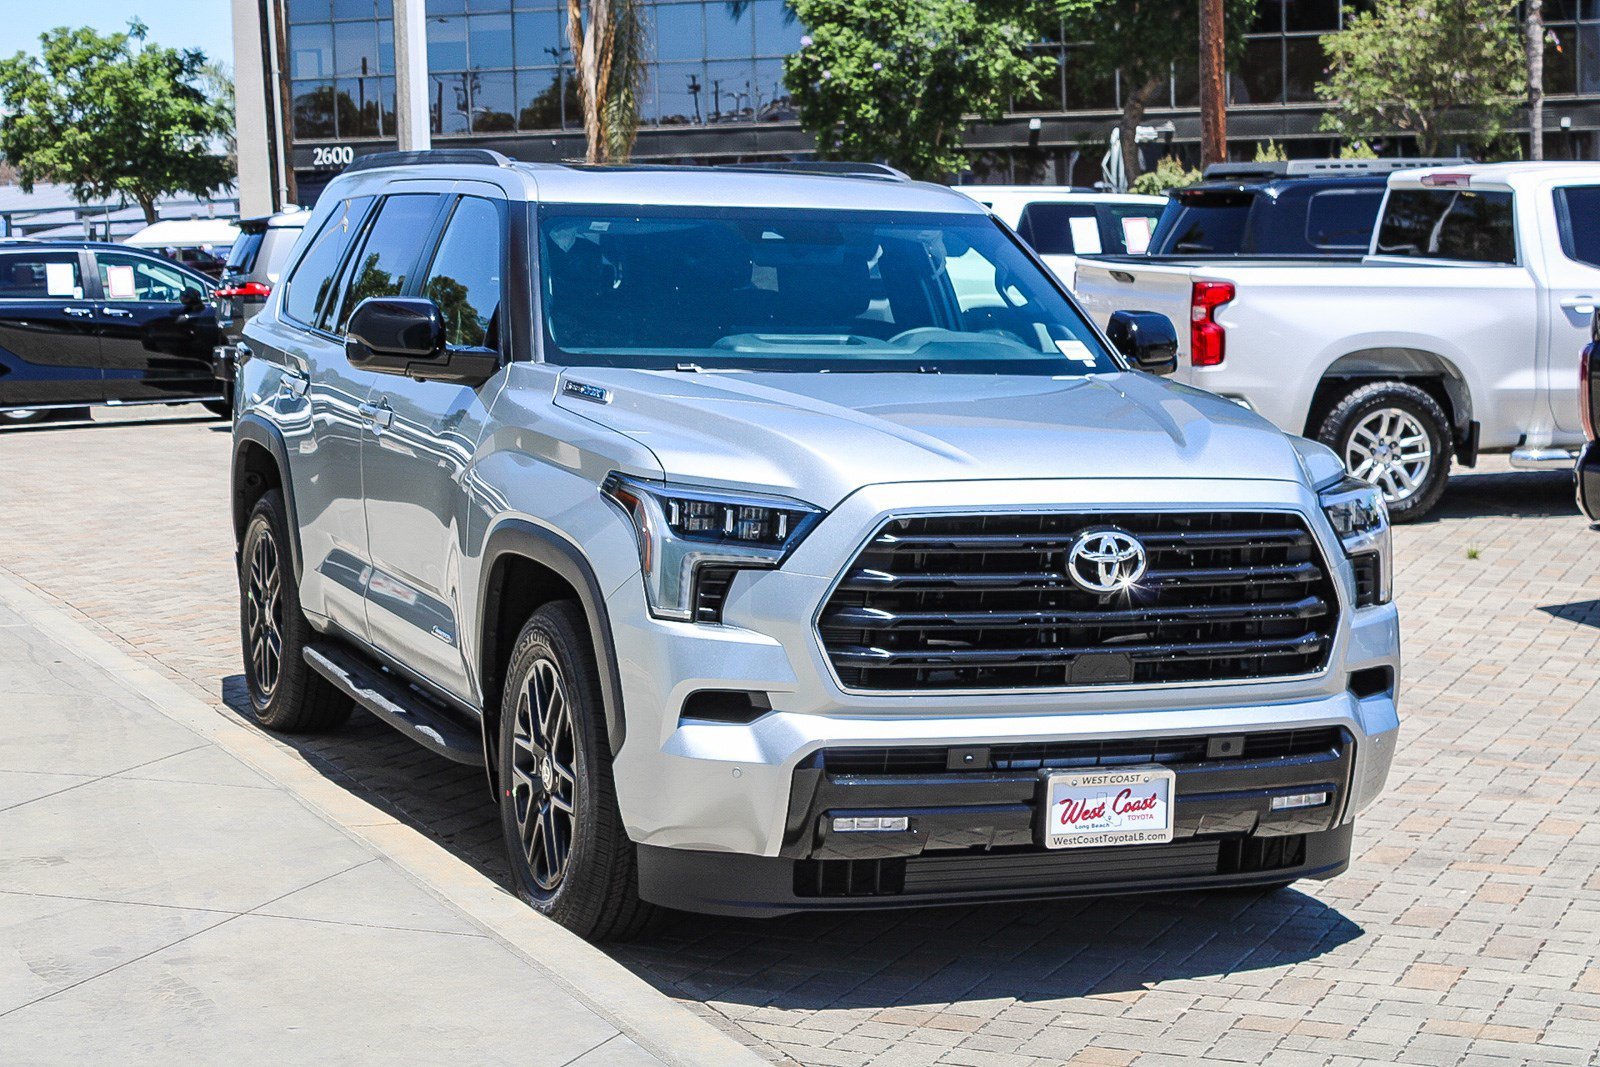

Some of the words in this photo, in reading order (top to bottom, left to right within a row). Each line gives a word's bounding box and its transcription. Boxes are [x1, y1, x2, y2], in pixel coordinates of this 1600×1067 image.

[313, 146, 354, 165] 2600
[1082, 776, 1107, 785] WEST
[1109, 775, 1140, 783] COAST
[1059, 798, 1106, 824] West
[1112, 788, 1157, 815] Coast
[1053, 833, 1166, 845] WestCoastToyotaLB.com
